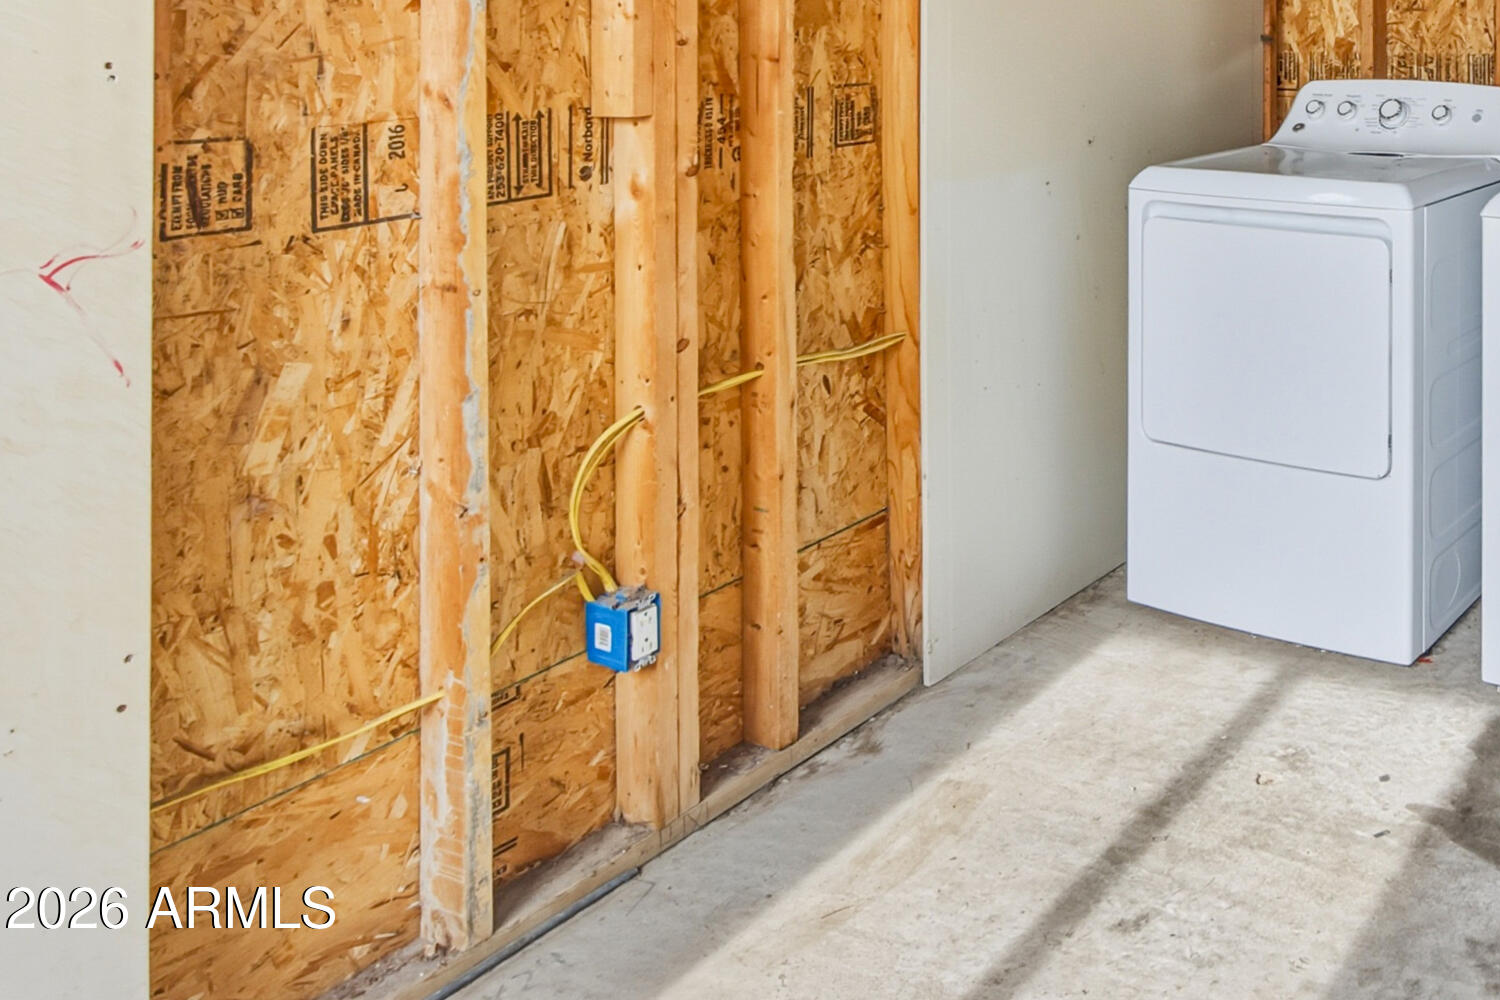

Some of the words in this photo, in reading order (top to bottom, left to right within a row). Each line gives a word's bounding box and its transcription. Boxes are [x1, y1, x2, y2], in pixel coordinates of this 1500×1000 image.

[319, 133, 328, 164] DOWN
[387, 124, 405, 160] 2016
[579, 107, 593, 162] Norbord
[330, 136, 339, 178] PANELS
[341, 147, 349, 174] SIDES
[172, 166, 182, 192] FROM
[232, 173, 243, 202] CARB
[319, 167, 328, 192] SIDE
[171, 195, 182, 231] EXEMPT
[320, 195, 328, 220] THIS
